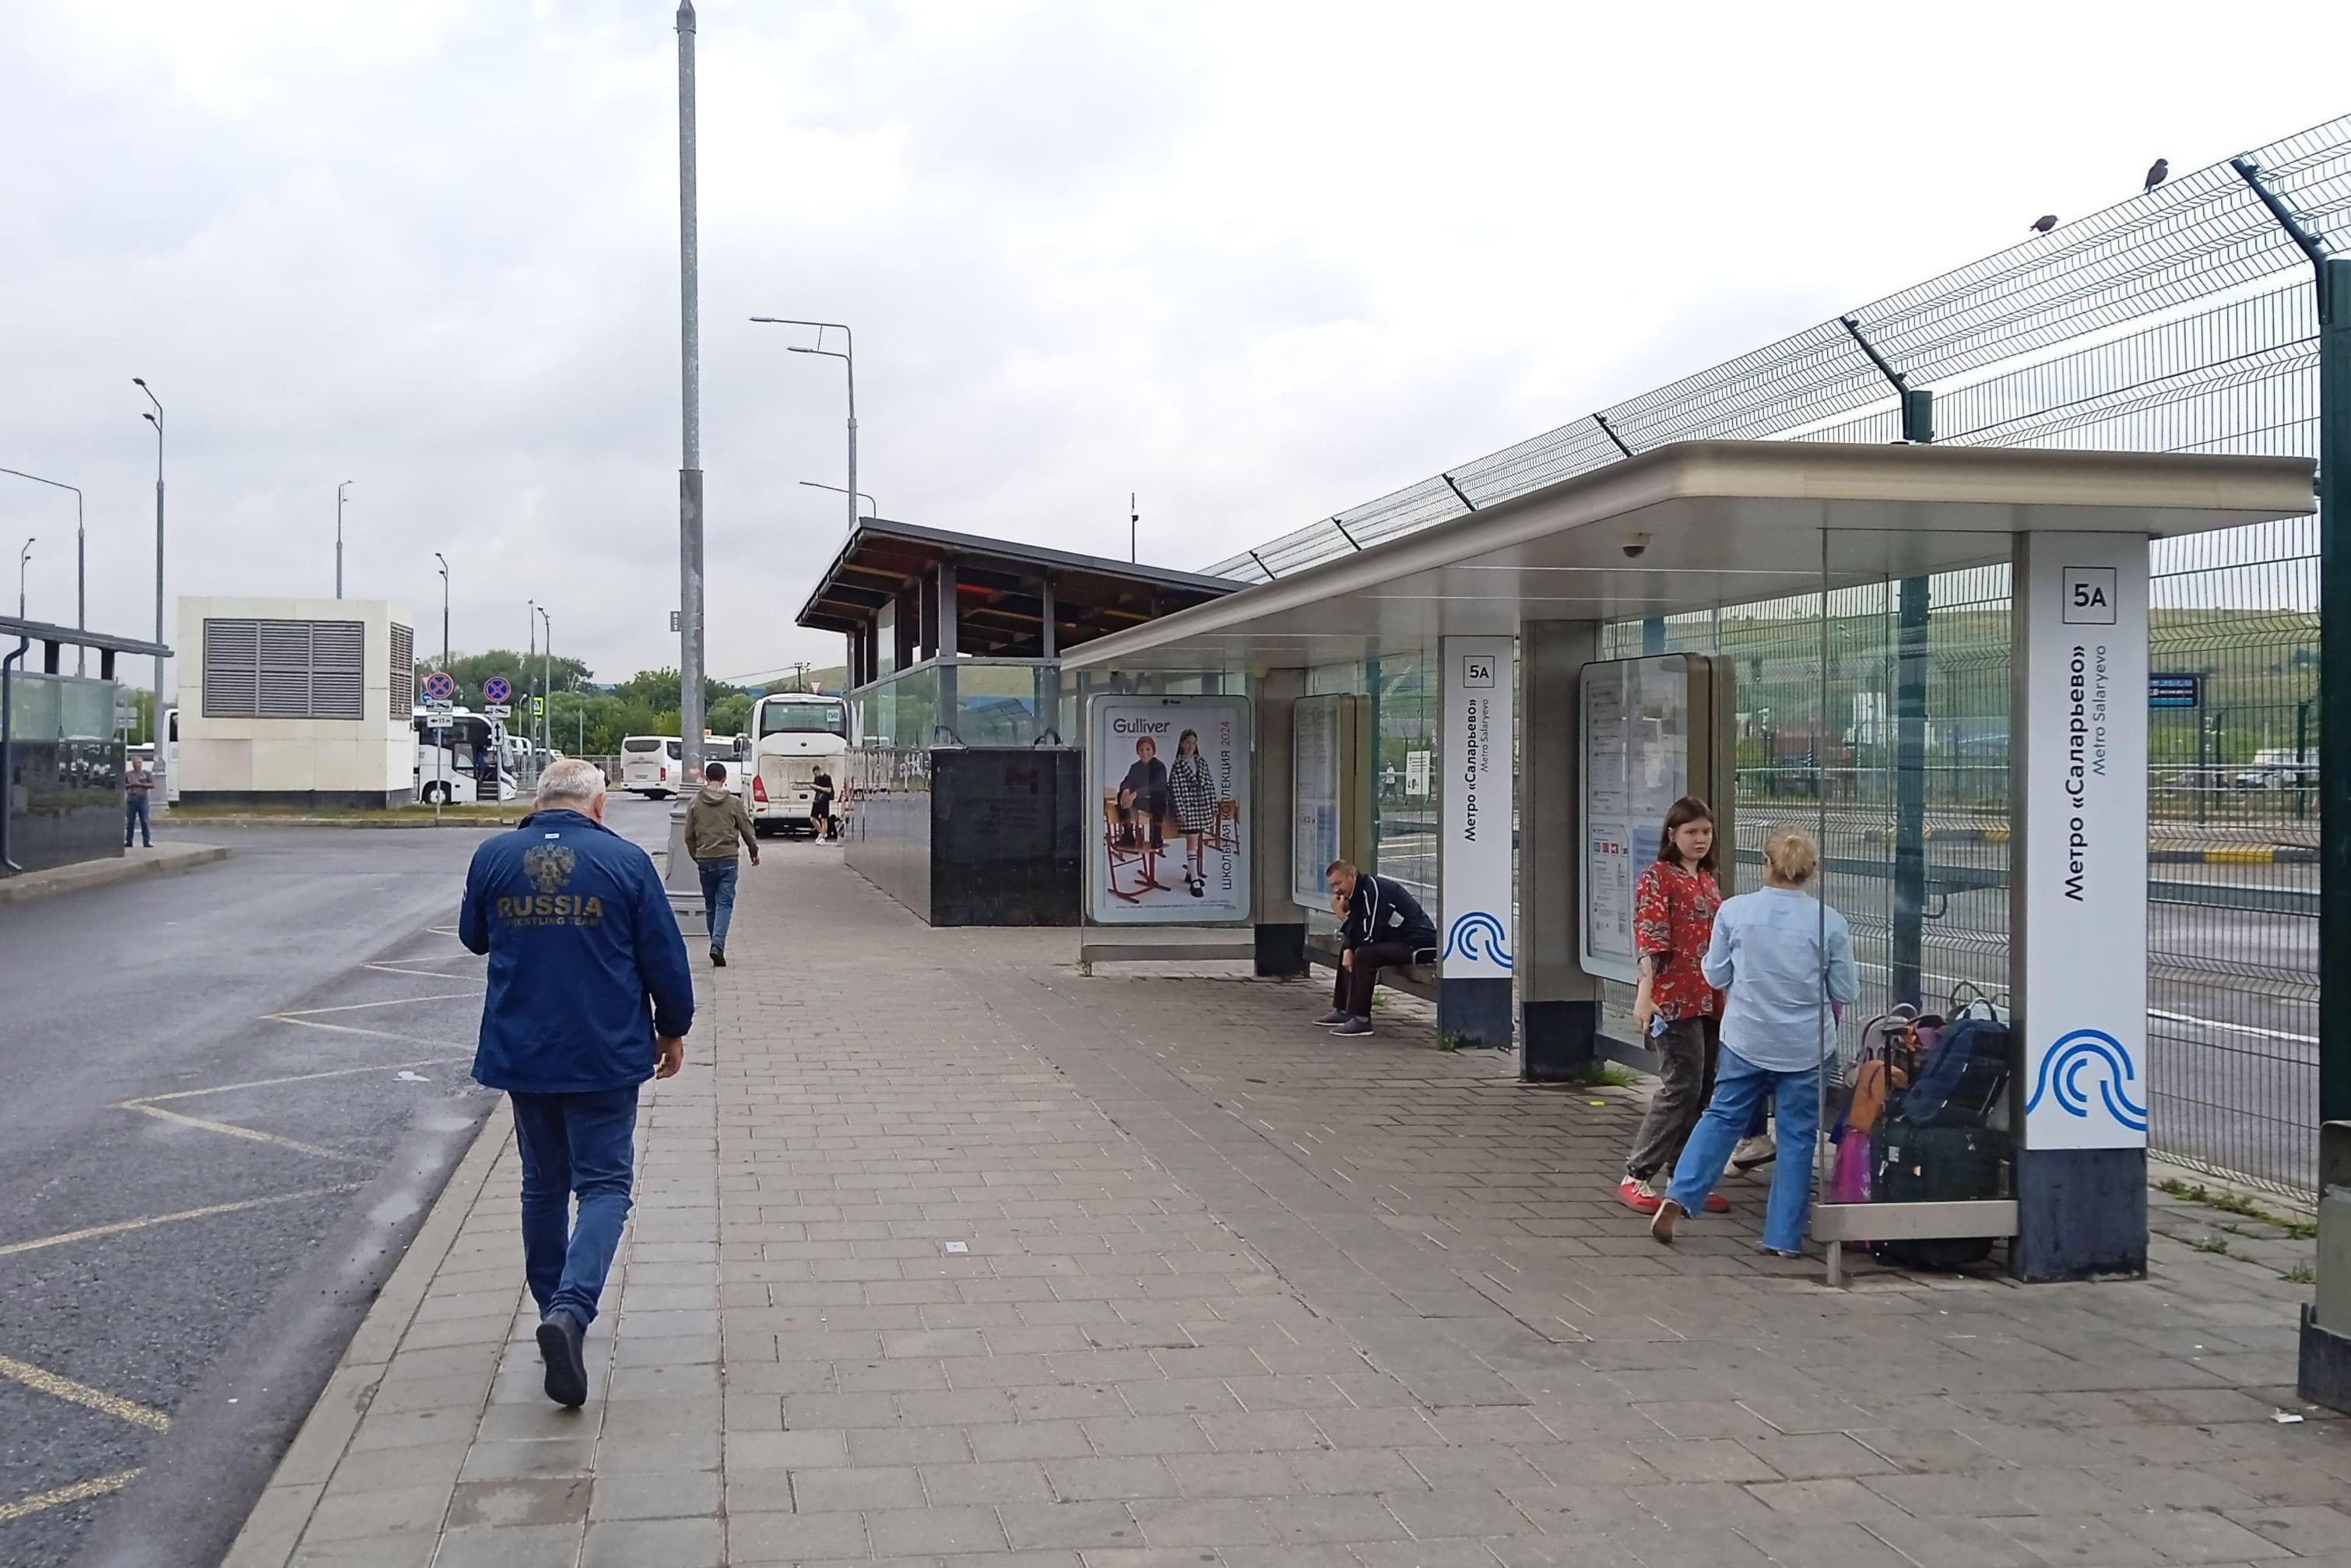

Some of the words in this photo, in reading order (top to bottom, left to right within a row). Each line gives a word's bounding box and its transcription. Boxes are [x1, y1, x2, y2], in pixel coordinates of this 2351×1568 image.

[2073, 583, 2107, 607] 5А
[1469, 664, 1490, 679] 5А
[2092, 645, 2109, 722] Salaryevo
[1112, 717, 1171, 733] Gulliver
[1220, 721, 1231, 746] 2024
[1481, 698, 1491, 742] Salaryevo
[2065, 645, 2089, 809] «Саларьево»
[1464, 699, 1479, 790] «Саларьево»
[1481, 744, 1489, 772] Metro
[2092, 726, 2106, 775] Metro
[1220, 750, 1233, 821] КОЛЛЕКЦИЯ
[1464, 794, 1478, 842] Метро
[1221, 824, 1232, 891] ШКОЛЬНАЯ
[2065, 817, 2088, 902] Метро
[497, 895, 603, 917] RUSSIA
